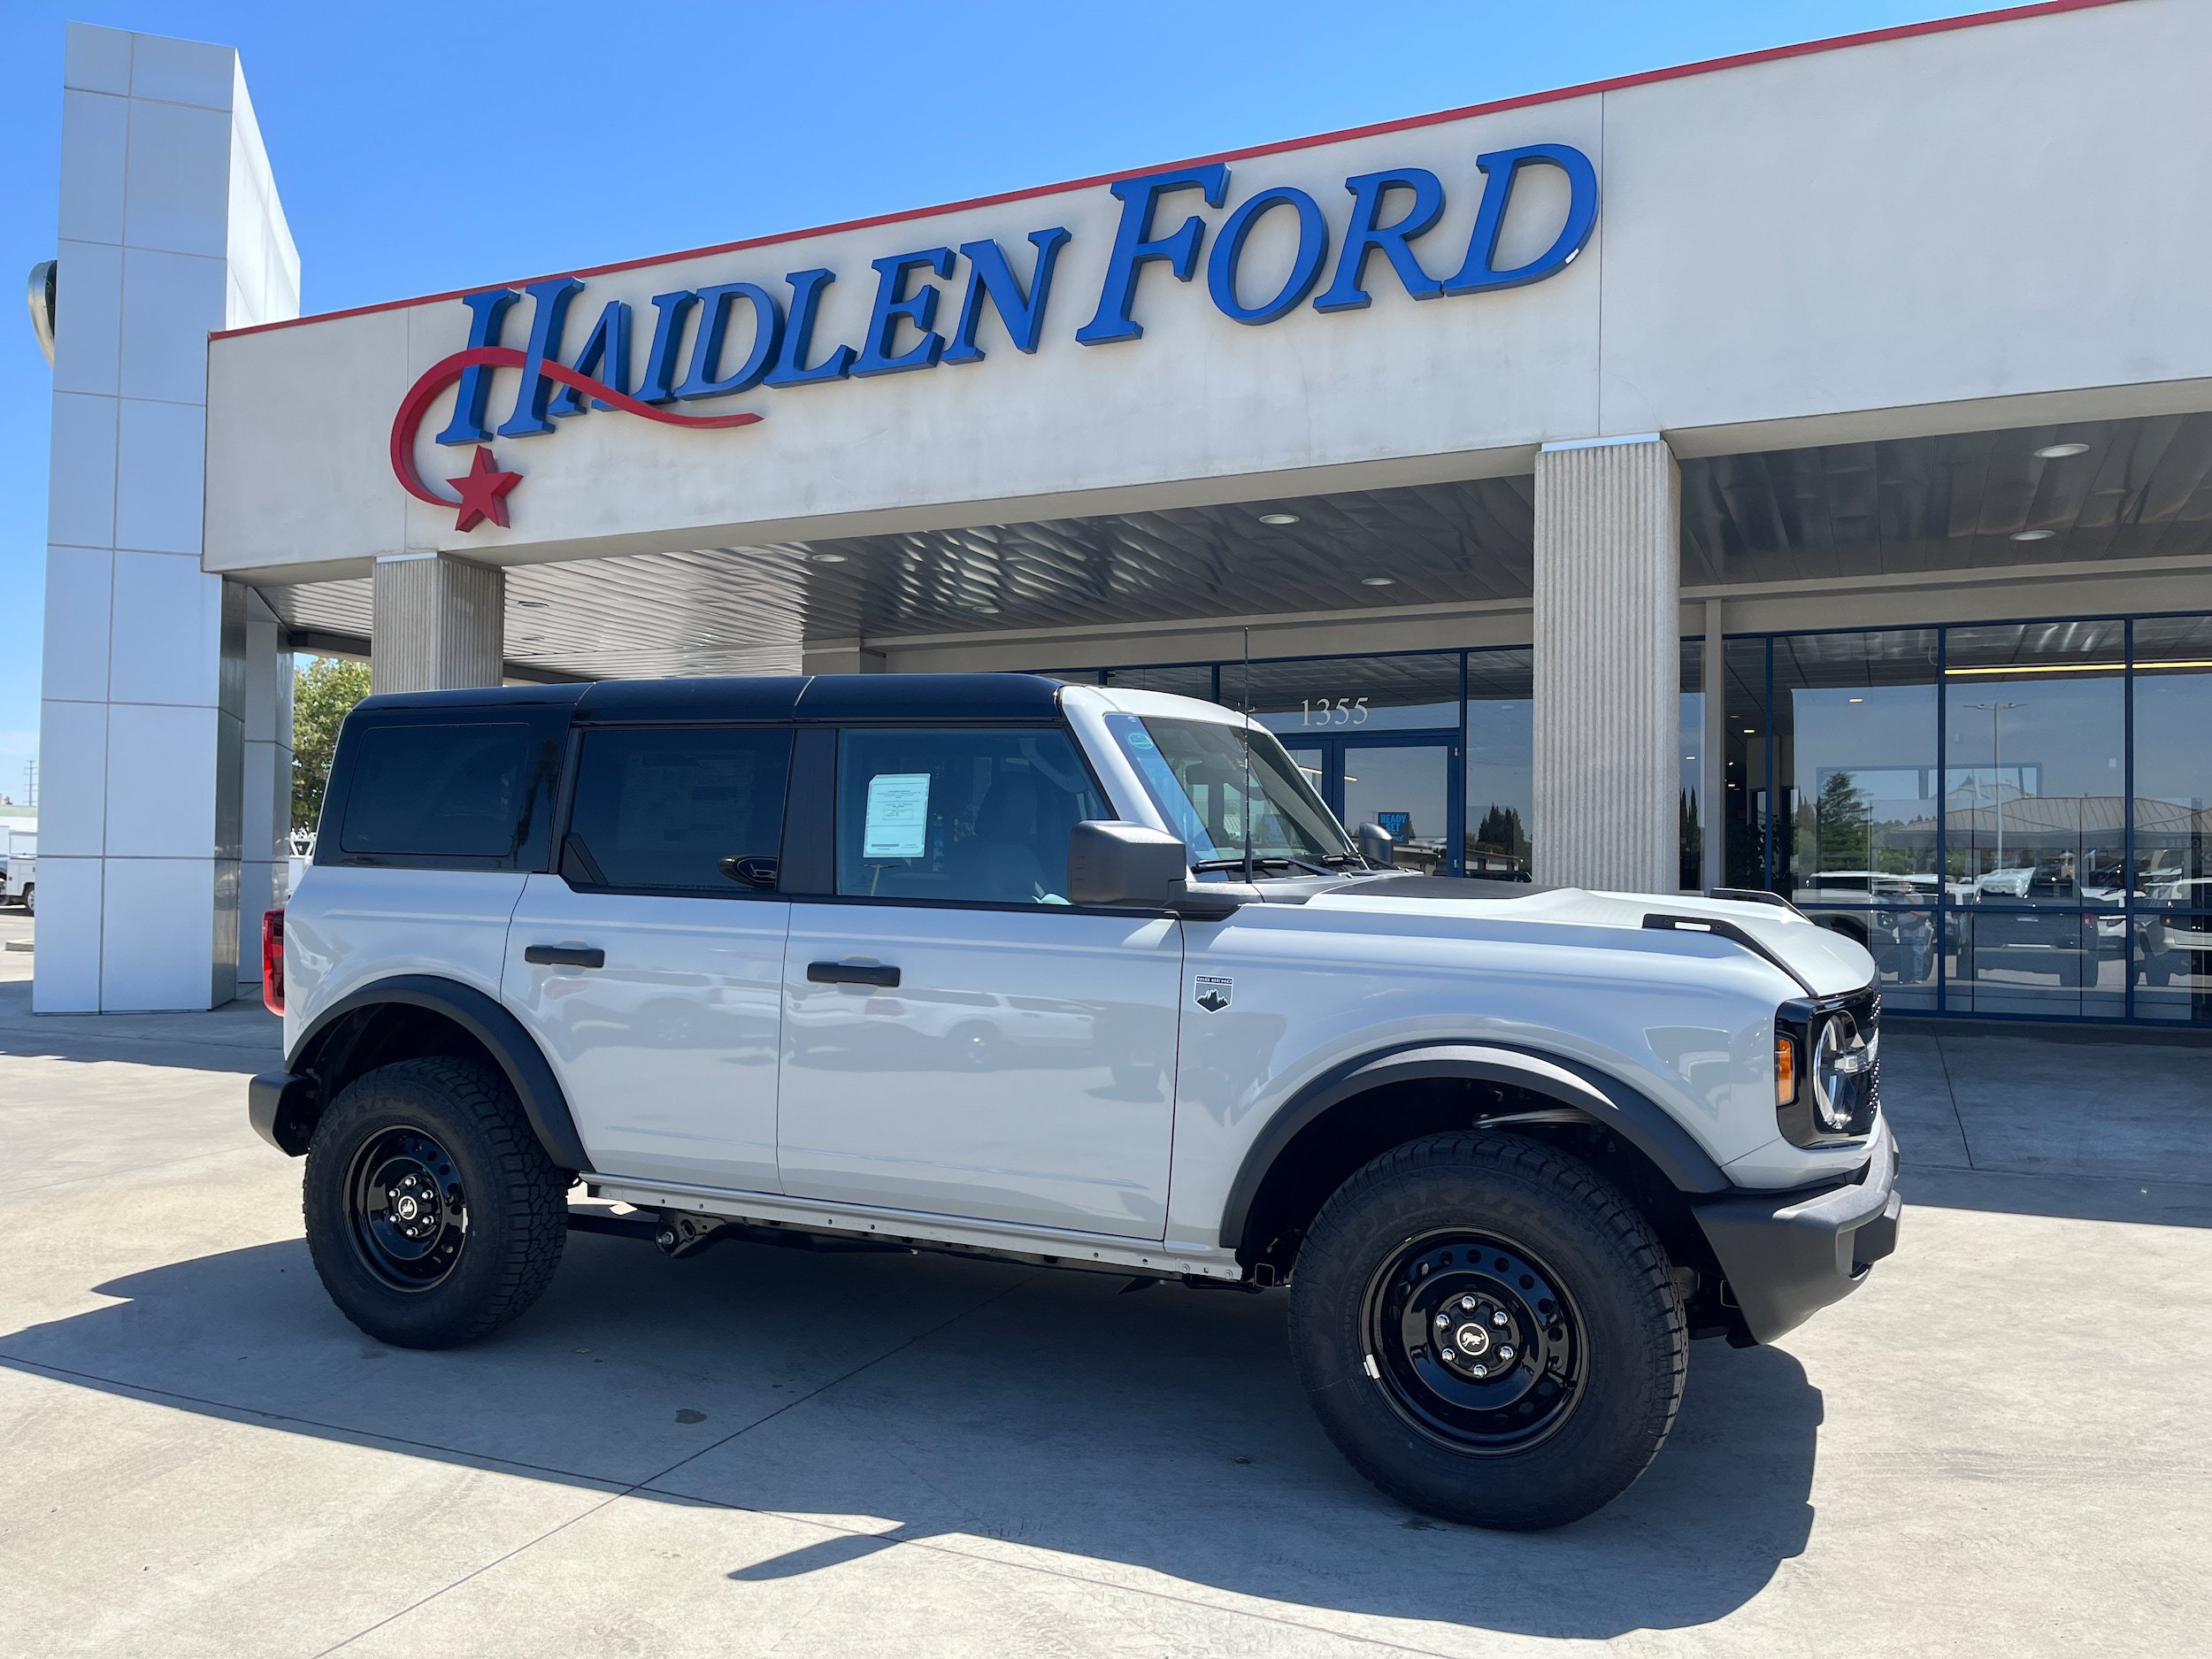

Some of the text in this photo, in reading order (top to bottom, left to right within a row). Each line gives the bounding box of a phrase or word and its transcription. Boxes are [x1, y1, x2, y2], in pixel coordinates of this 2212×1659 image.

[435, 142, 1600, 446] HAIDLEN FORD
[1301, 697, 1369, 726] 1355
[1380, 814, 1407, 823] READY
[1386, 823, 1400, 832] SET
